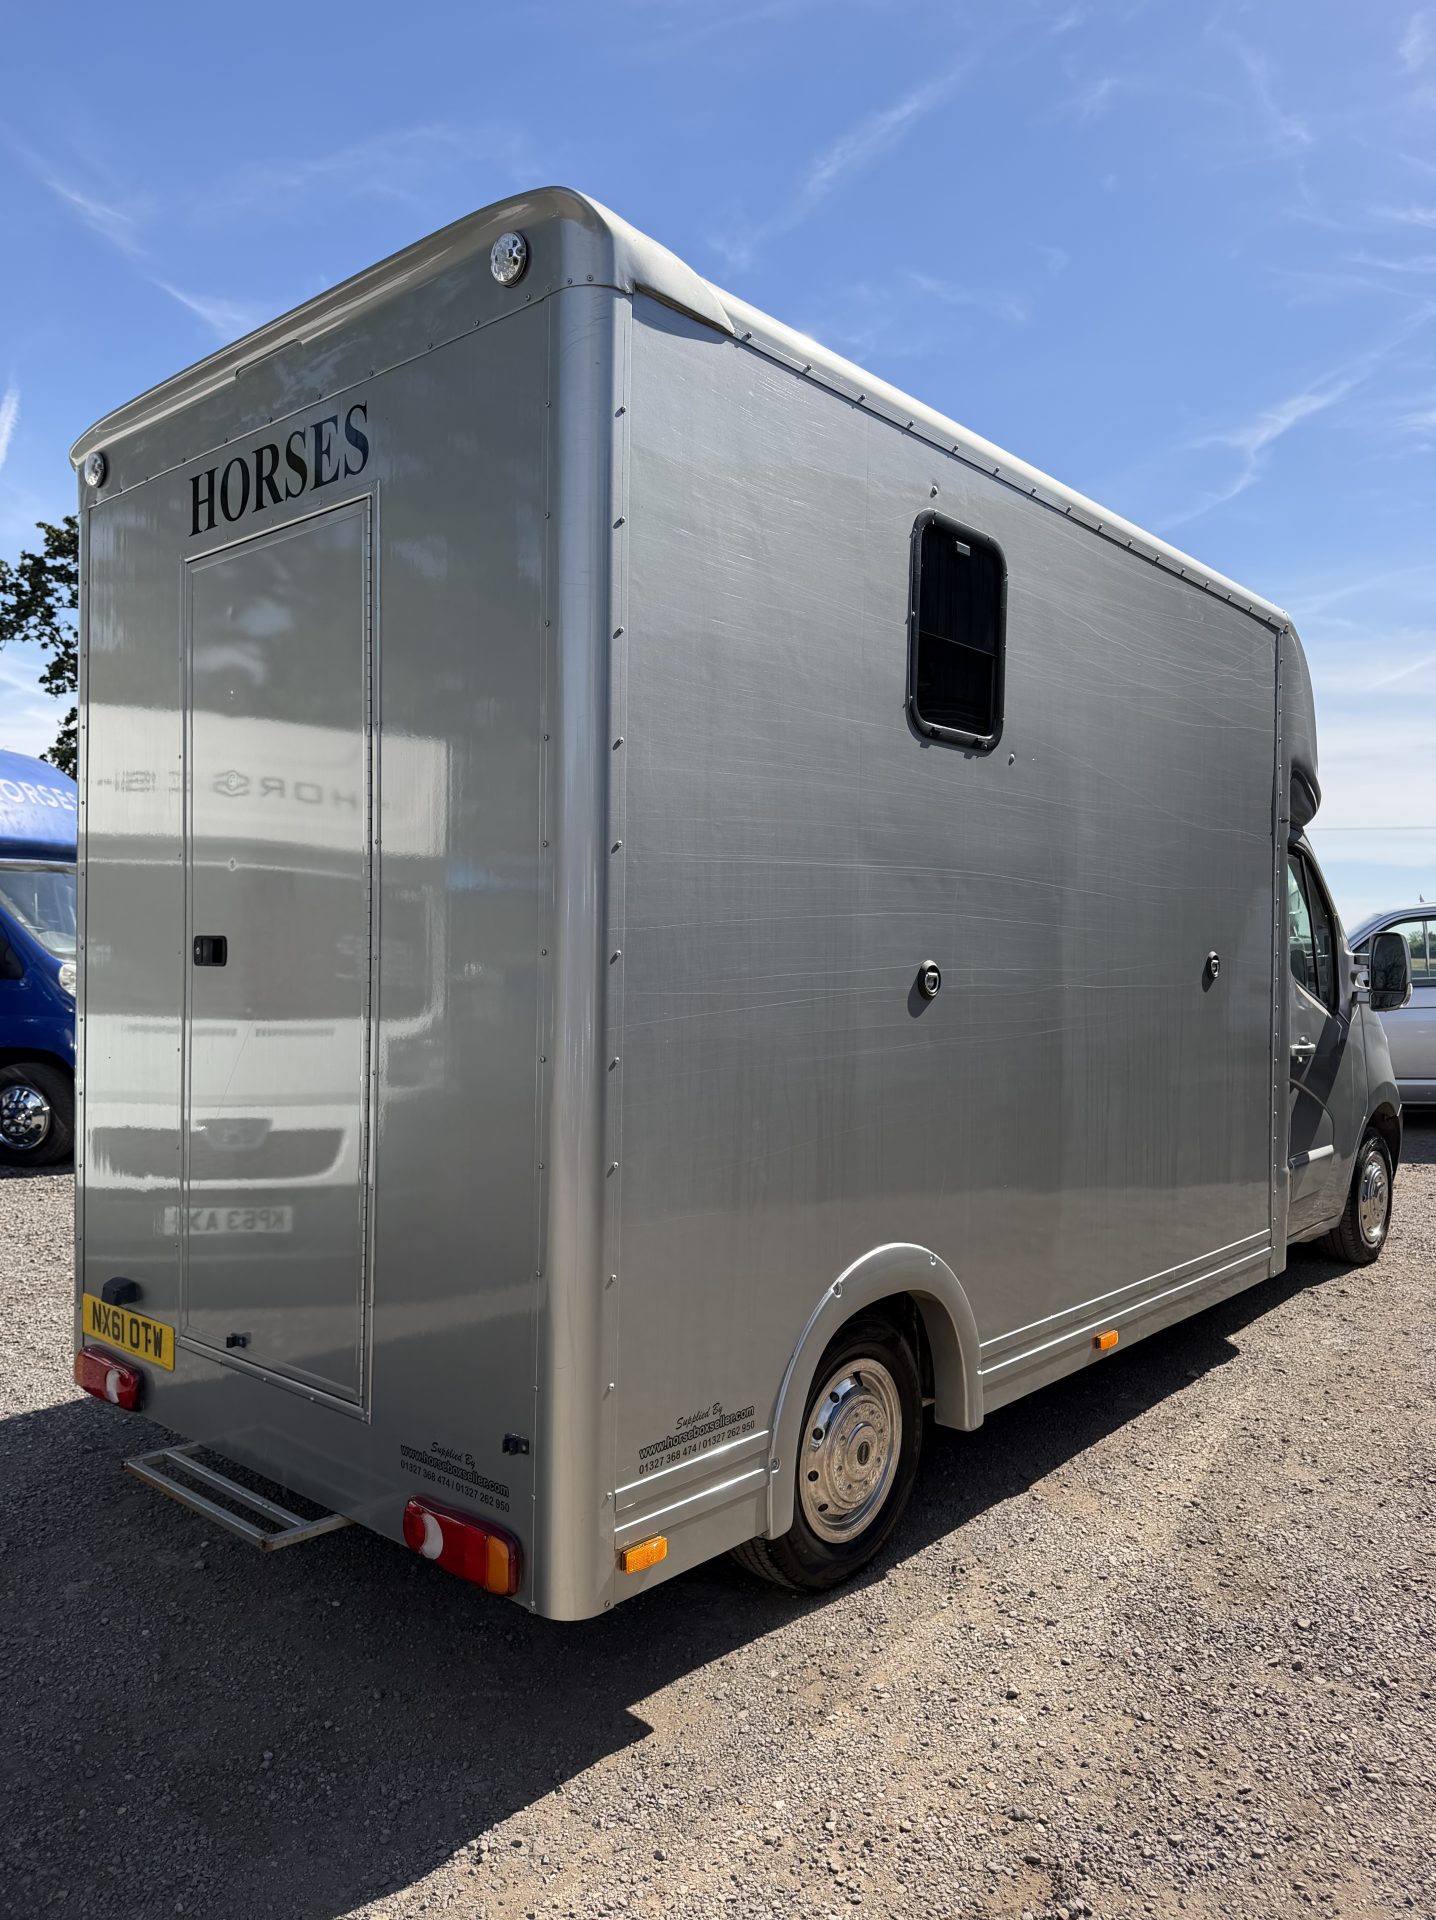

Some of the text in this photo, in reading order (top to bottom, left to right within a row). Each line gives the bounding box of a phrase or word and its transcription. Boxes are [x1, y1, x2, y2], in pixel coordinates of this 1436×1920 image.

[189, 400, 370, 537] HORSES
[0, 778, 77, 811] ORSES
[93, 1301, 163, 1359] NX61 OTW
[638, 1405, 755, 1460] www.horseboxseller.com
[676, 1402, 723, 1430] Supplied By
[400, 1444, 510, 1498] www.horseboxseller.com
[430, 1441, 476, 1470] Supplied By
[638, 1456, 664, 1475] 01327
[666, 1449, 680, 1464] 368
[682, 1443, 697, 1456] 474
[702, 1432, 725, 1449] 01327
[727, 1425, 740, 1439] 262
[741, 1419, 755, 1433] 950
[400, 1460, 421, 1476] 01327
[423, 1468, 436, 1482] 368
[438, 1475, 450, 1489] 474
[455, 1483, 478, 1499] 01327
[480, 1492, 494, 1506] 262
[495, 1499, 510, 1513] 950
